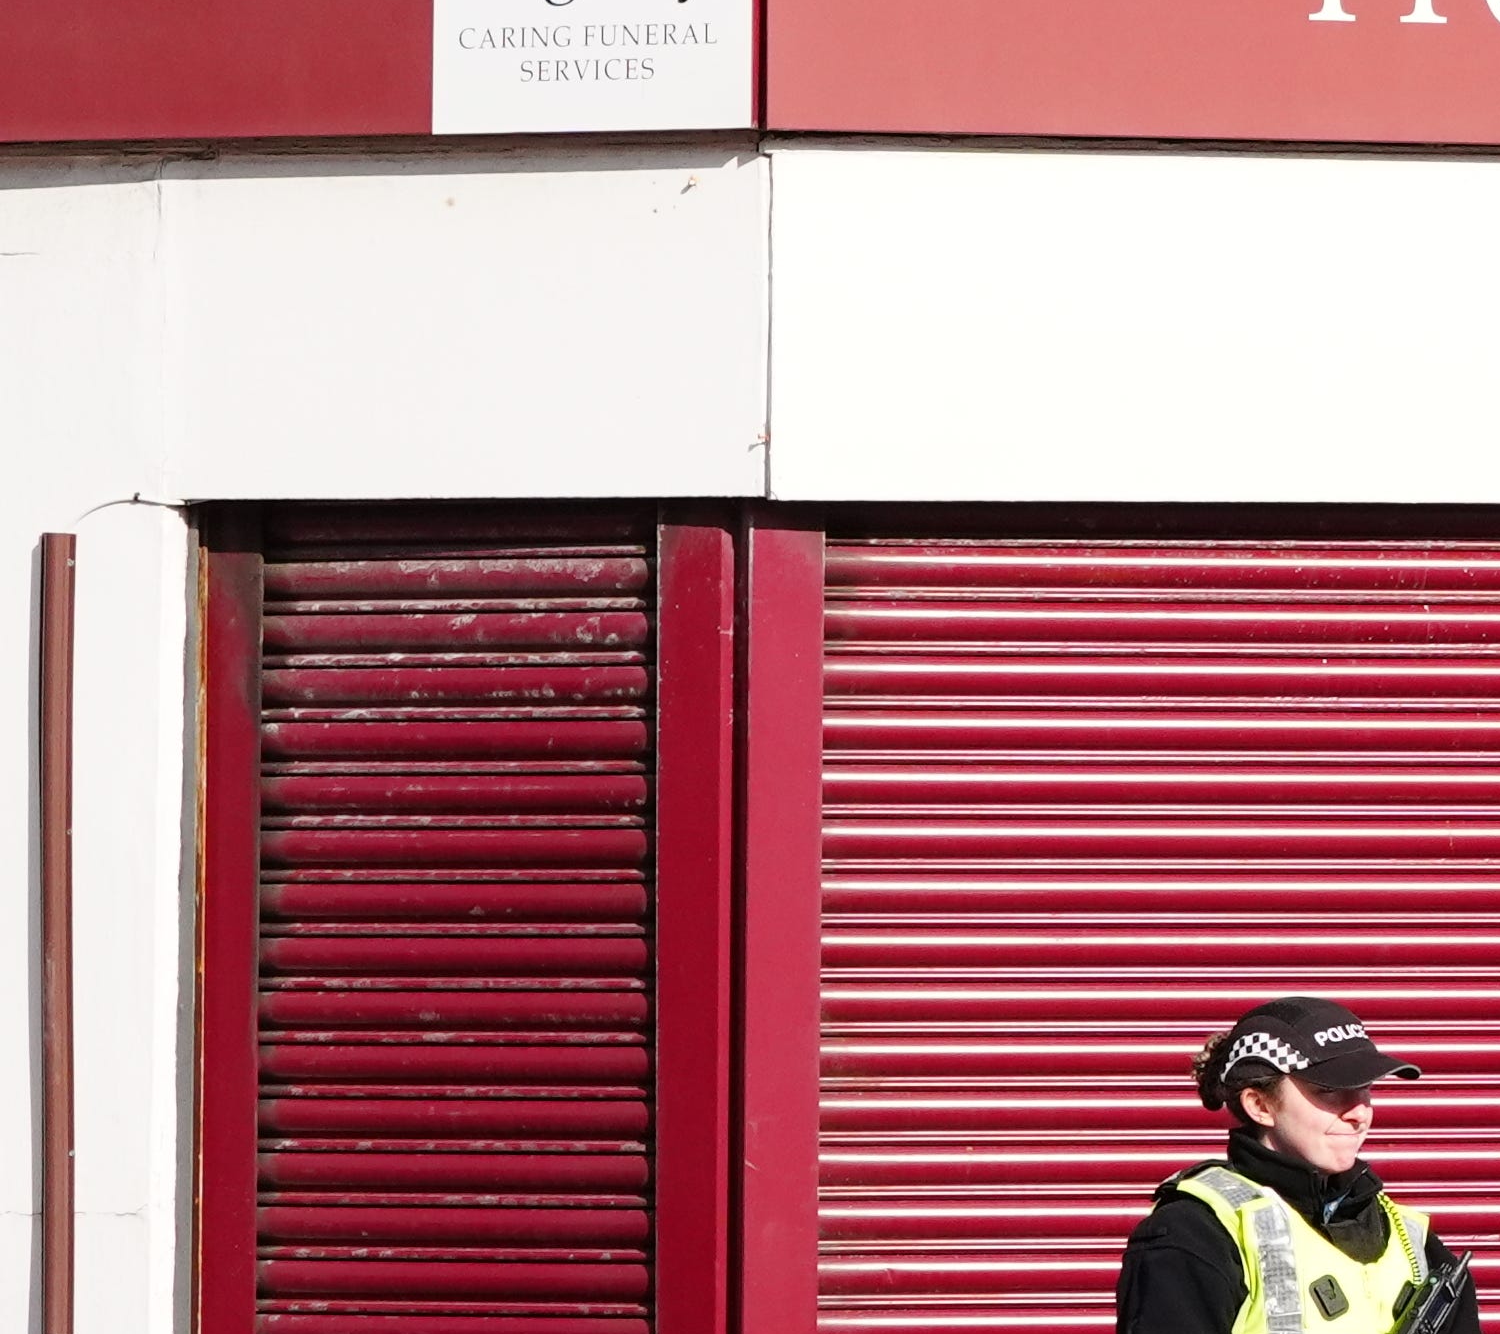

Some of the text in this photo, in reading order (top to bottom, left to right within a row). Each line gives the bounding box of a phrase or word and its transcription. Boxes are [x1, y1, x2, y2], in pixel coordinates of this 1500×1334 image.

[459, 22, 719, 50] CARING FUNERAL
[520, 57, 655, 83] SERVICES
